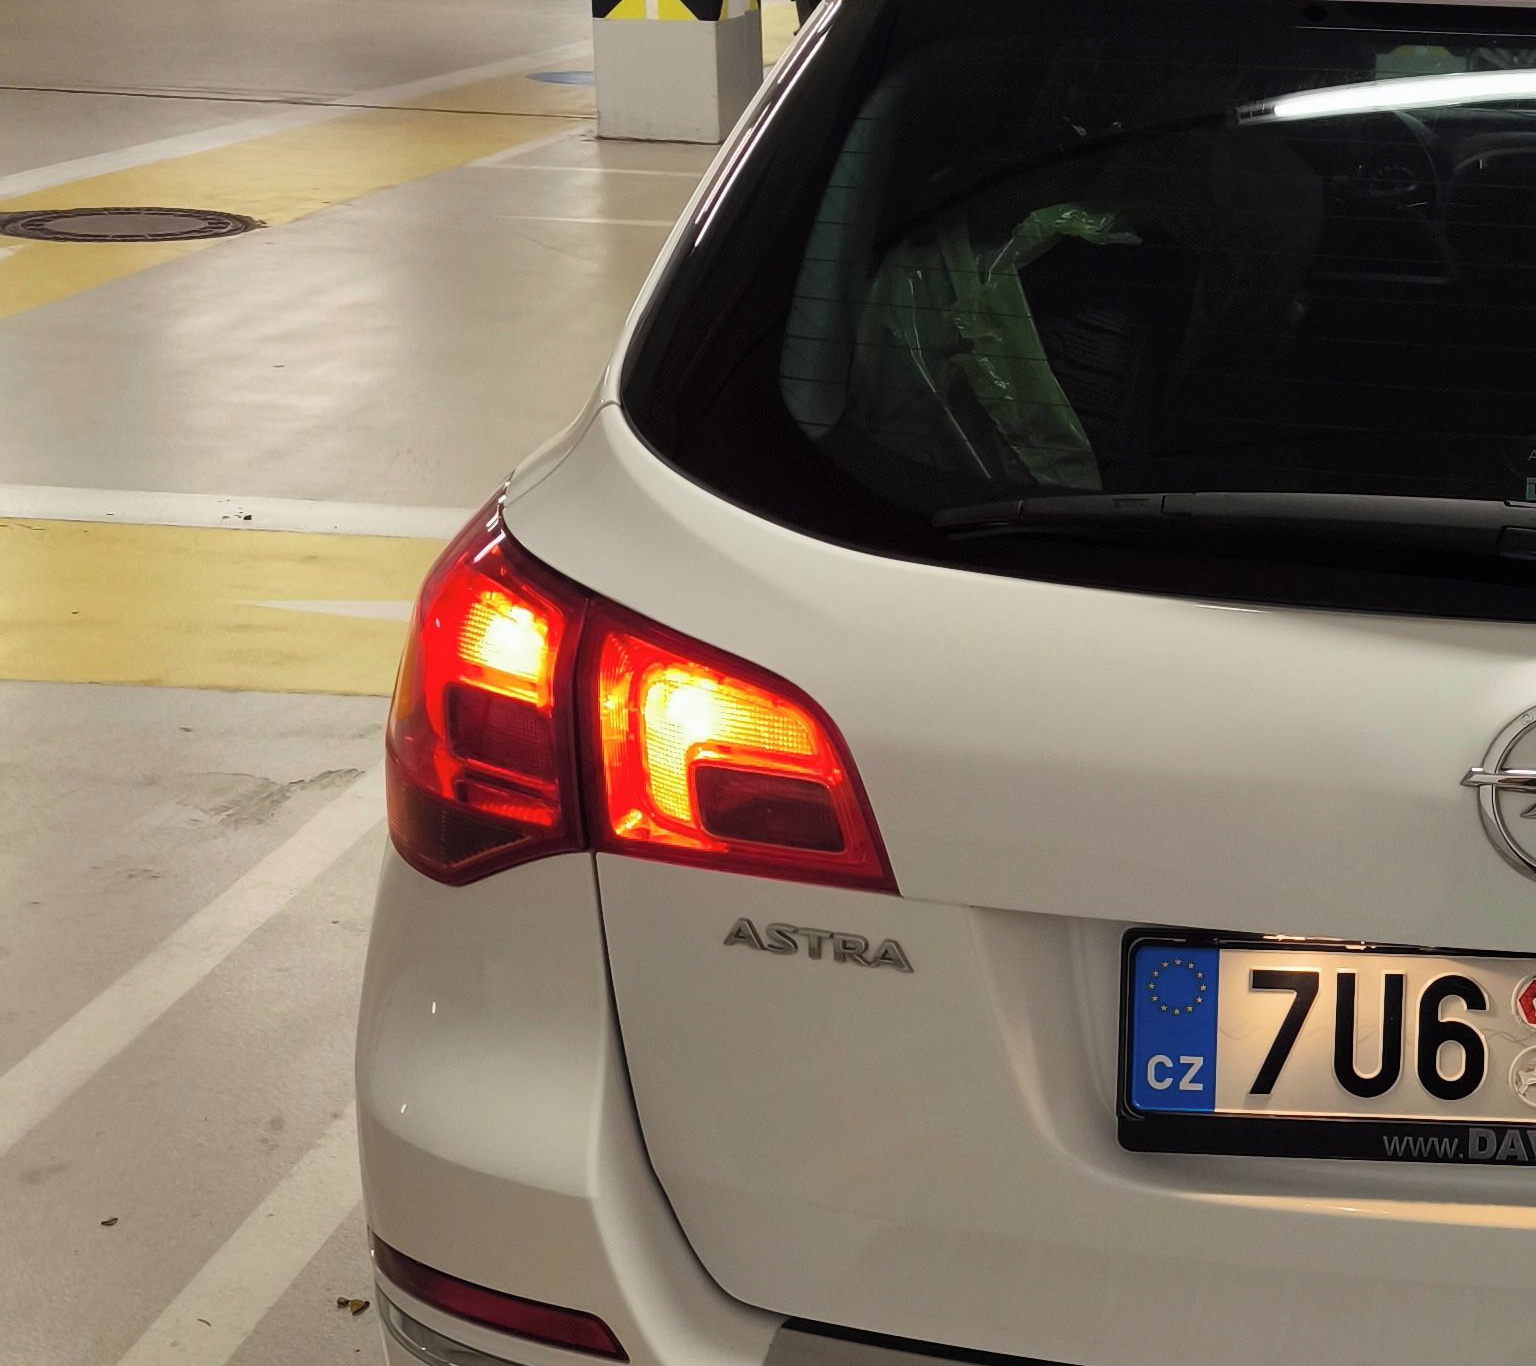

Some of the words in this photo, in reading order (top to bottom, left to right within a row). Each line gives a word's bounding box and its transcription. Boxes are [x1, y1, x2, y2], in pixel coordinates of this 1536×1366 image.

[723, 917, 914, 973] ASTRA
[1249, 969, 1489, 1101] 7U6
[1147, 1054, 1204, 1091] CZ
